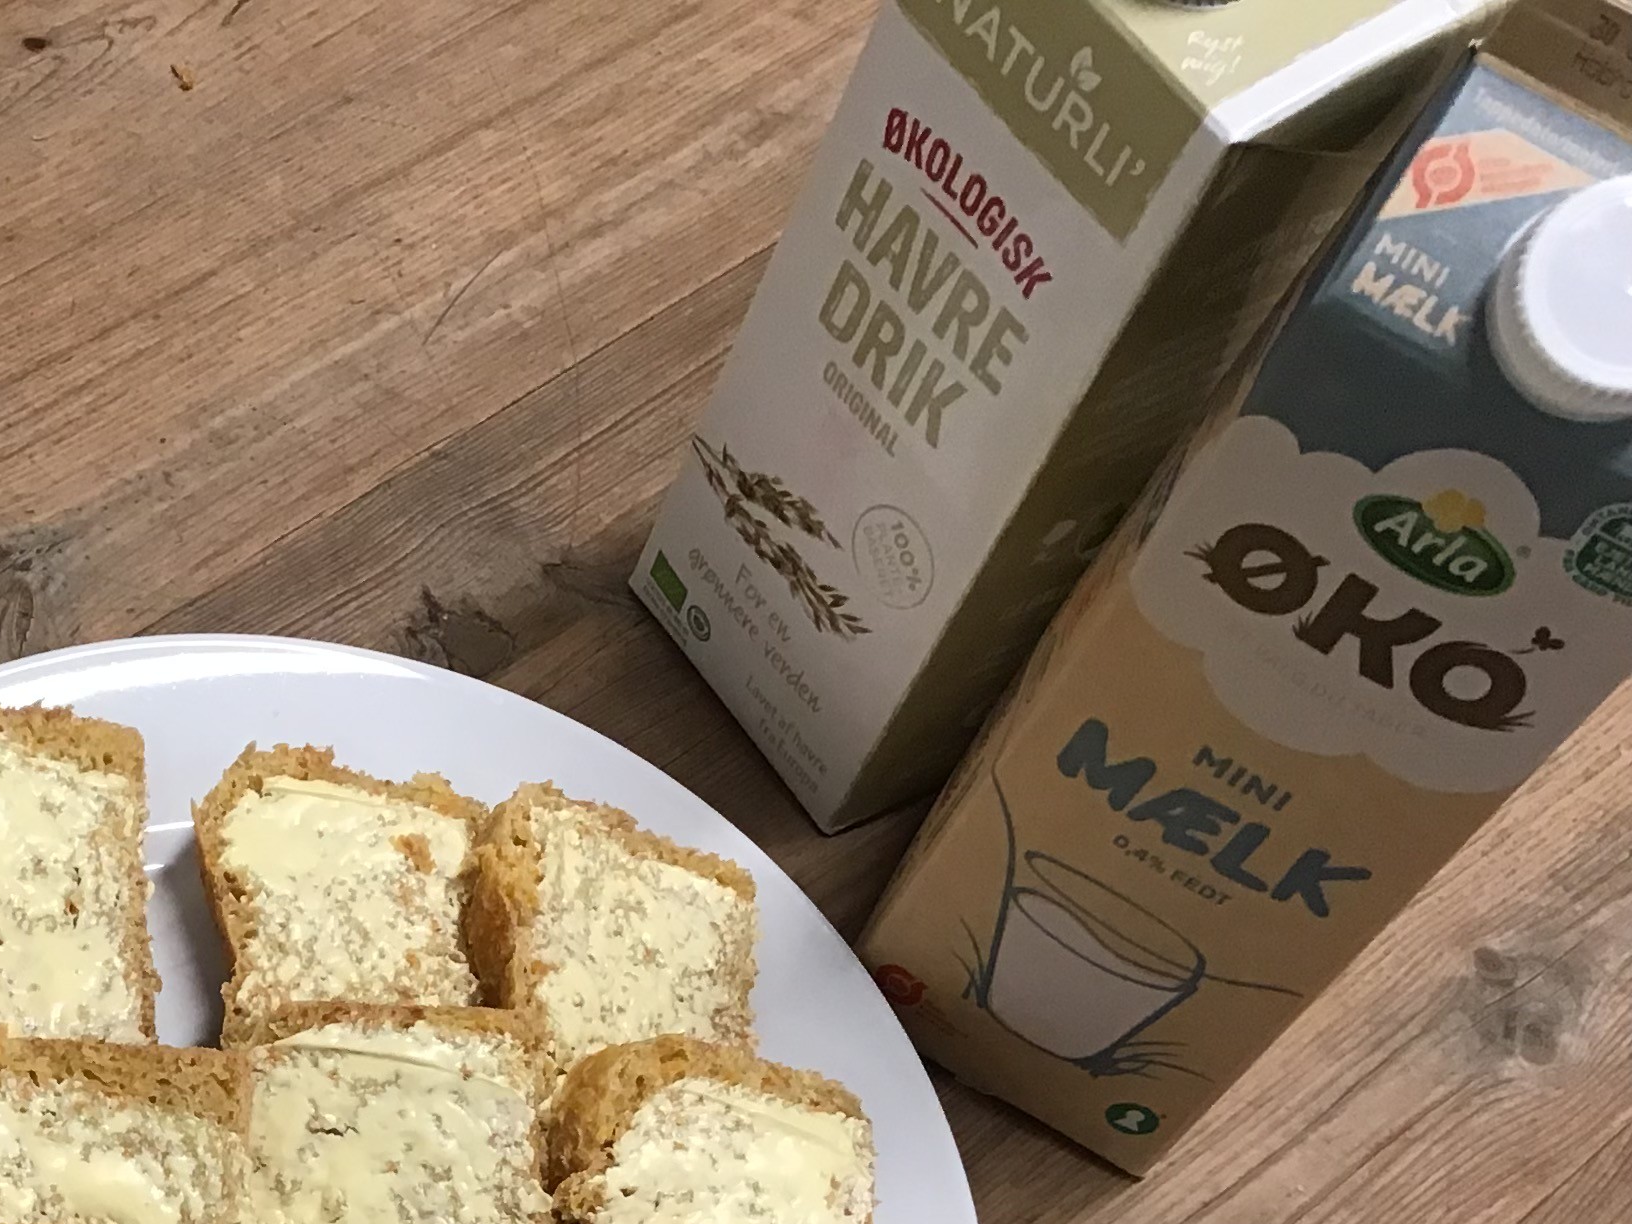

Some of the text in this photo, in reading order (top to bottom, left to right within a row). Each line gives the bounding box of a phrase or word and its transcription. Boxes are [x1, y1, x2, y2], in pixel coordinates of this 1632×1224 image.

[882, 107, 1053, 300] ØKOLOGISK
[835, 158, 1030, 396] HAVRE
[1374, 232, 1450, 289] MINI
[1351, 261, 1472, 347] MÆLK
[819, 259, 968, 449] DRIK
[823, 360, 900, 458] ORIGINAL
[734, 562, 766, 609] For
[887, 519, 923, 592] 100%
[1374, 511, 1488, 584] Arla
[1184, 523, 1538, 732] ØKO
[764, 640, 823, 715] verden
[1056, 717, 1372, 919] MÆLK
[1192, 744, 1294, 812] MINI
[1112, 833, 1232, 906] 0,4% FEDT
